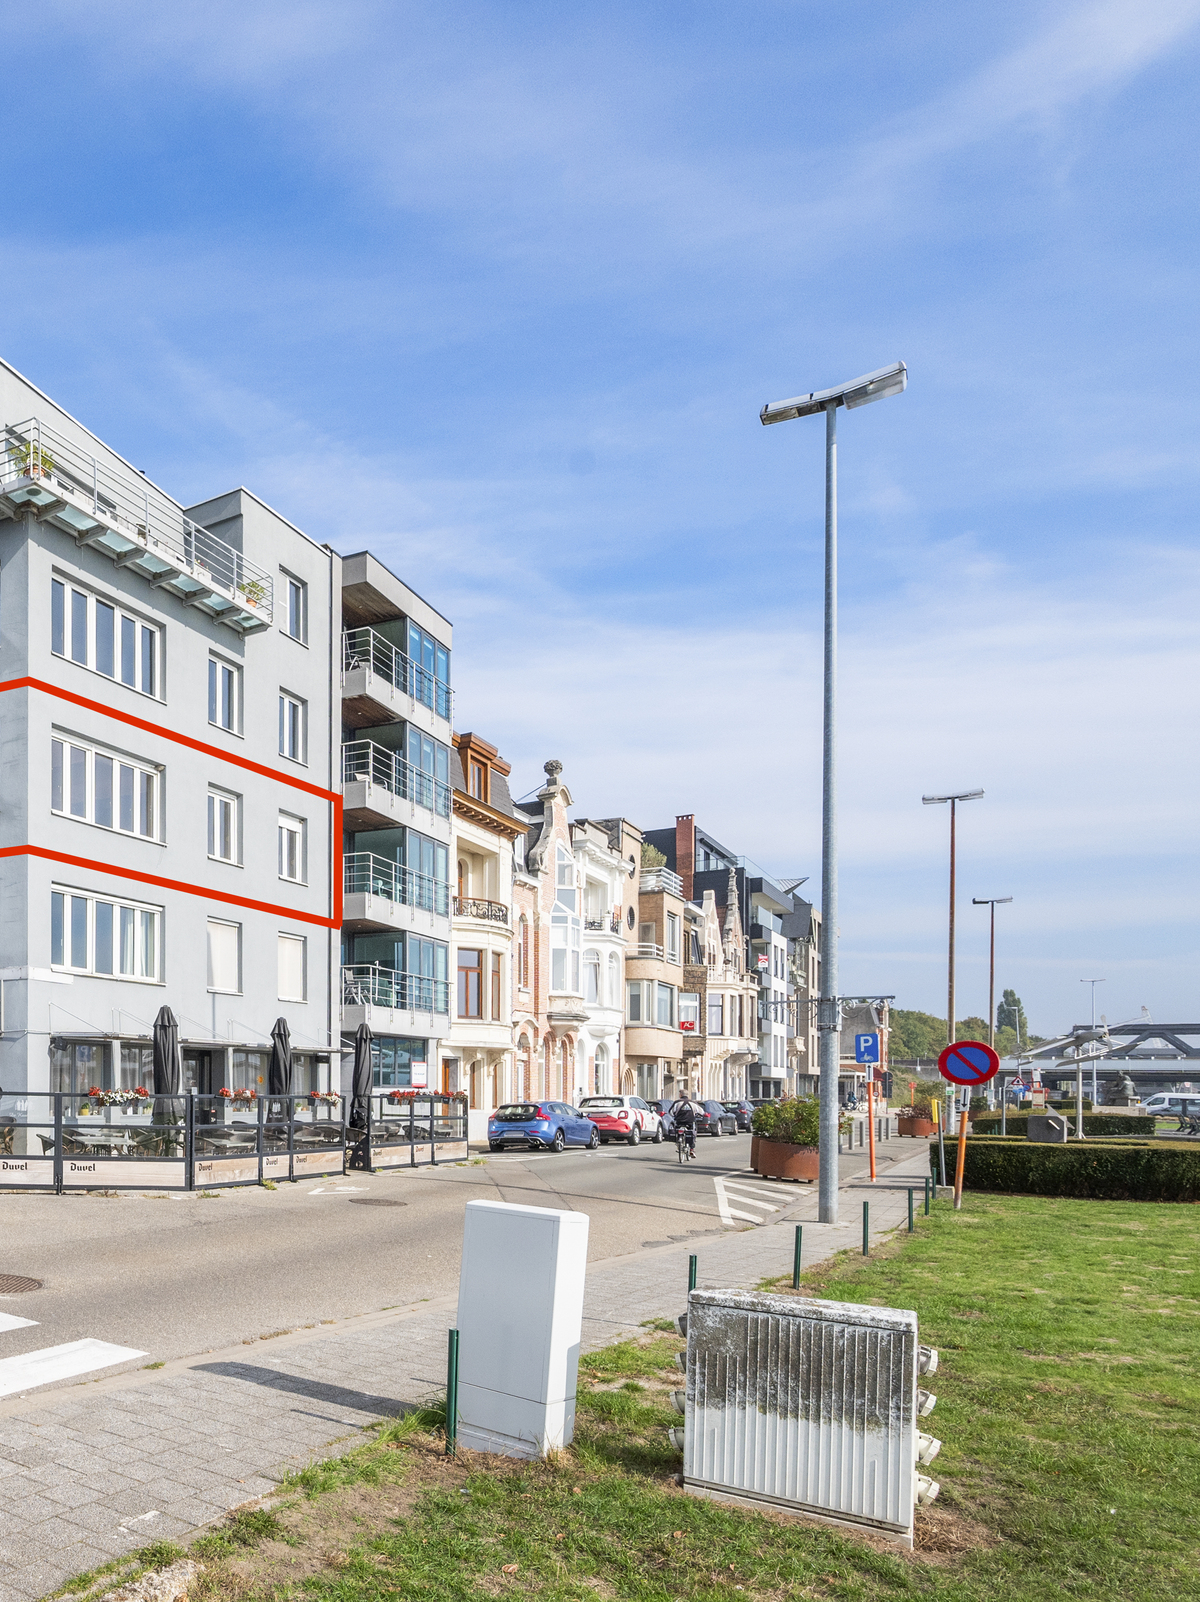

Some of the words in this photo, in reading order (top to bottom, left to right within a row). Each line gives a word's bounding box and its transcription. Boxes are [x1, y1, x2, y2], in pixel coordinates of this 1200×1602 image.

[860, 1036, 872, 1051] P
[2, 1161, 28, 1171] Duvel
[198, 1162, 213, 1171] Duvel
[266, 1157, 278, 1166] Duvel
[70, 1162, 96, 1172] Duvel
